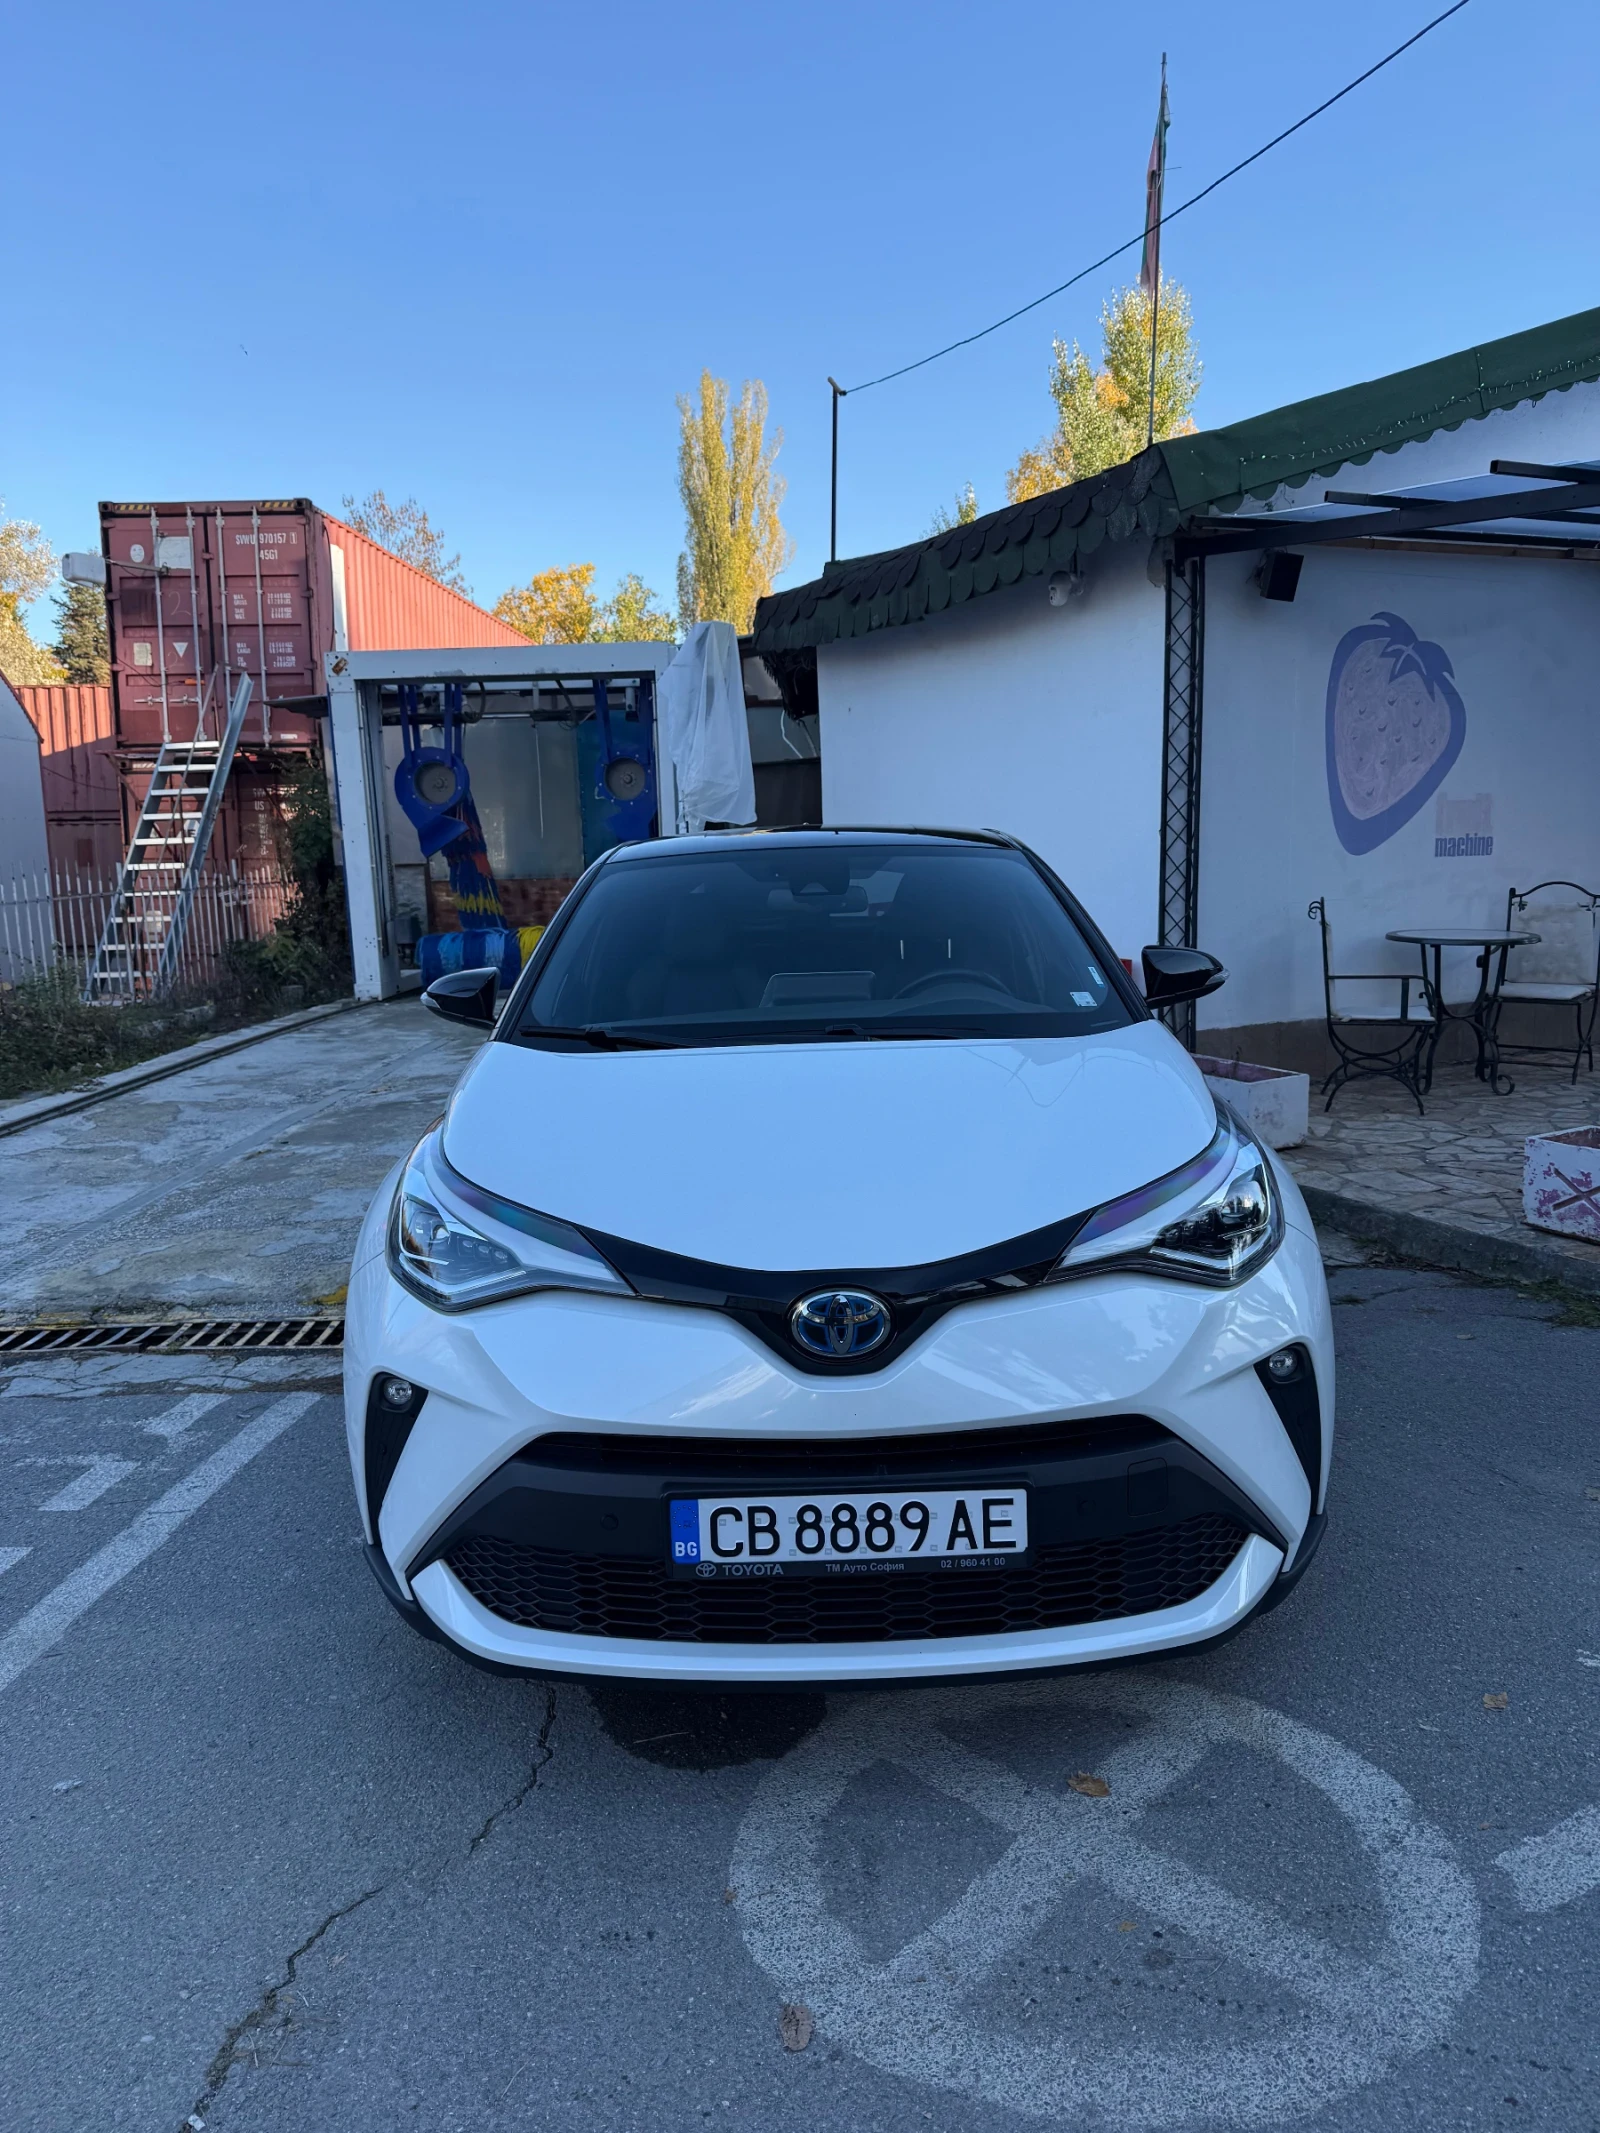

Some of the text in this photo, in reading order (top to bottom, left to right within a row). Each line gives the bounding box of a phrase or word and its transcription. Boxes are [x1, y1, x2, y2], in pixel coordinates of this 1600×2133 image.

[260, 549, 278, 560] 45G1
[1435, 833, 1494, 857] machine
[710, 1497, 1017, 1558] CB 8889 AE
[674, 1541, 698, 1557] BG
[825, 1562, 905, 1574] ТМ Ауто София
[940, 1560, 952, 1568] 02
[960, 1558, 977, 1567] 960
[979, 1557, 991, 1566] 41
[994, 1557, 1006, 1566] 00
[722, 1563, 784, 1576] TOYOTA
